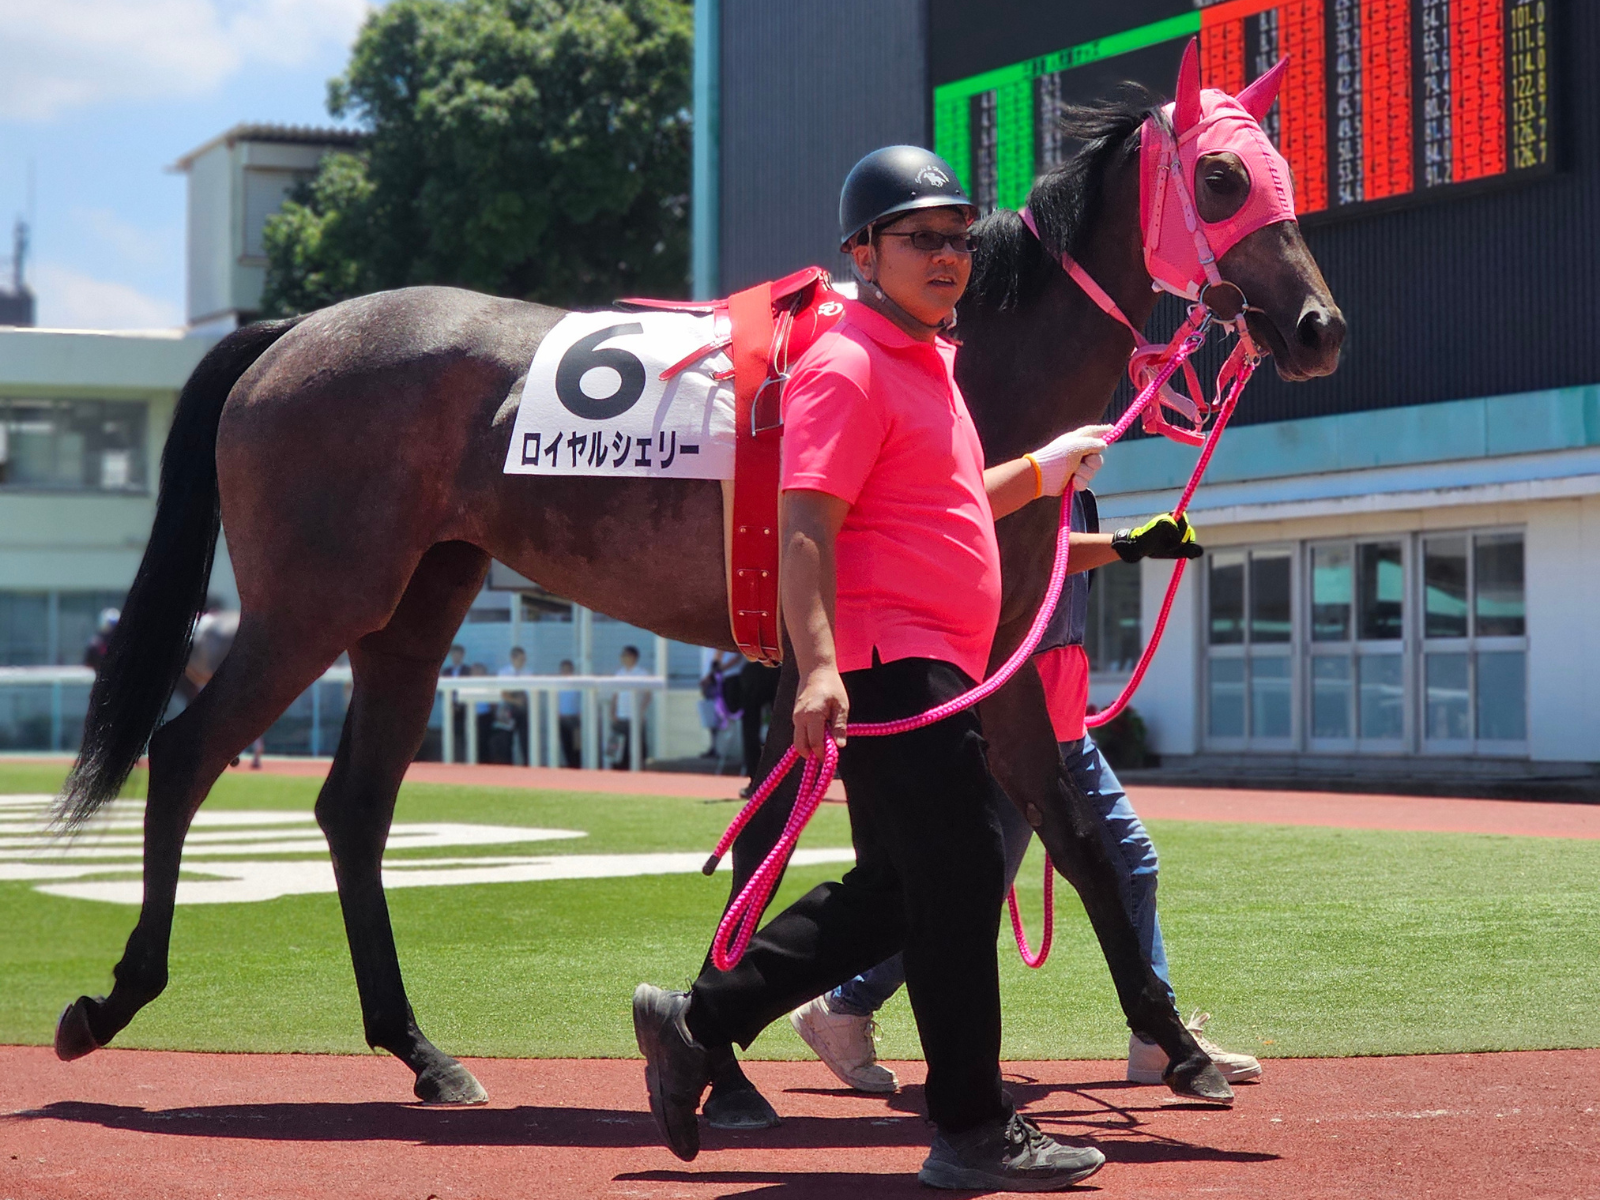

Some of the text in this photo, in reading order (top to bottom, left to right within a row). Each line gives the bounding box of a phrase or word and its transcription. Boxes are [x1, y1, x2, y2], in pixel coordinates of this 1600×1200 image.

[1511, 1, 1545, 29] 101.0
[1511, 24, 1546, 52] 111.6
[1512, 48, 1546, 76] 114.0
[1512, 71, 1547, 99] 122.8
[1513, 94, 1547, 122] 123.7
[554, 322, 646, 420] 6
[521, 430, 700, 469] ロイヤルシェリー
